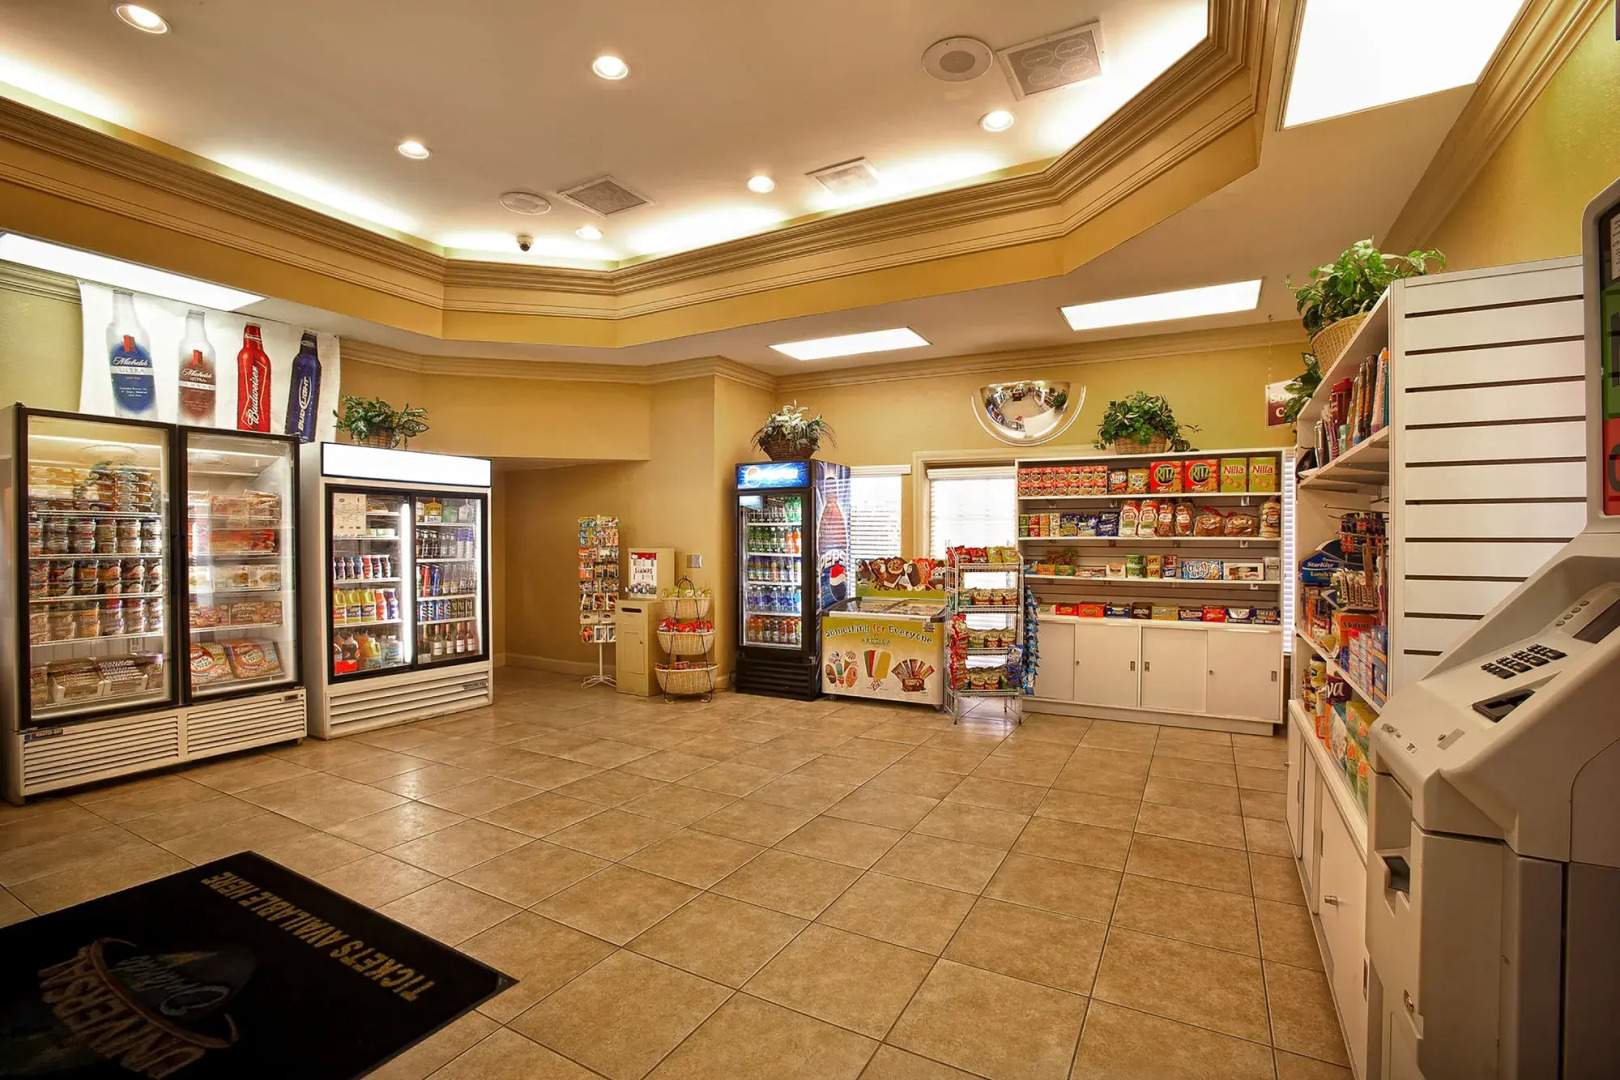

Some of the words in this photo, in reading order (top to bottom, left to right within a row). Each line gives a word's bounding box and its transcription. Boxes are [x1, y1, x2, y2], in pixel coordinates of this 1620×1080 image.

[247, 365, 260, 425] Budweiser
[301, 376, 310, 406] LIGHT
[298, 409, 306, 431] BUD
[1155, 467, 1175, 482] RITZ
[1189, 464, 1211, 481] RITZ
[1223, 465, 1245, 475] Nilla
[1252, 464, 1274, 474] Nilla
[820, 549, 848, 569] PEPS
[825, 624, 870, 638] Something
[872, 623, 886, 633] for
[888, 625, 933, 644] Everyone
[201, 870, 262, 901] HERE
[237, 889, 351, 948] AVAILABLE
[329, 940, 436, 1002] TICKETS
